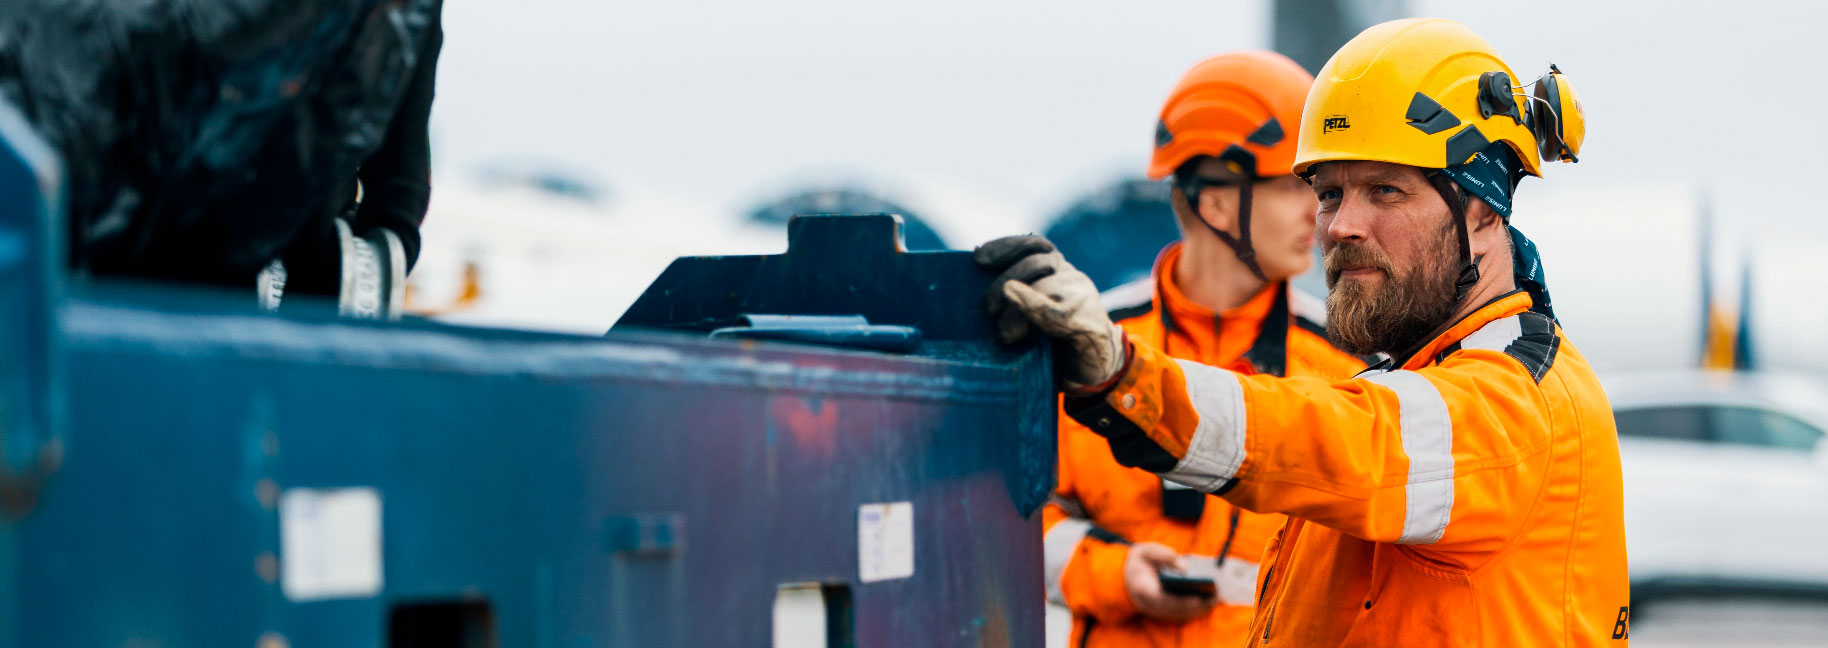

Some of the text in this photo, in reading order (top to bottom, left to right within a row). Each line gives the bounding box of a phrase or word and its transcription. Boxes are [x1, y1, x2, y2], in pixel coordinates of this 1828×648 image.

[1323, 117, 1350, 134] PETZL
[1461, 171, 1485, 188] LUMISE
[1484, 195, 1507, 212] LUMISE
[1612, 606, 1629, 640] B
